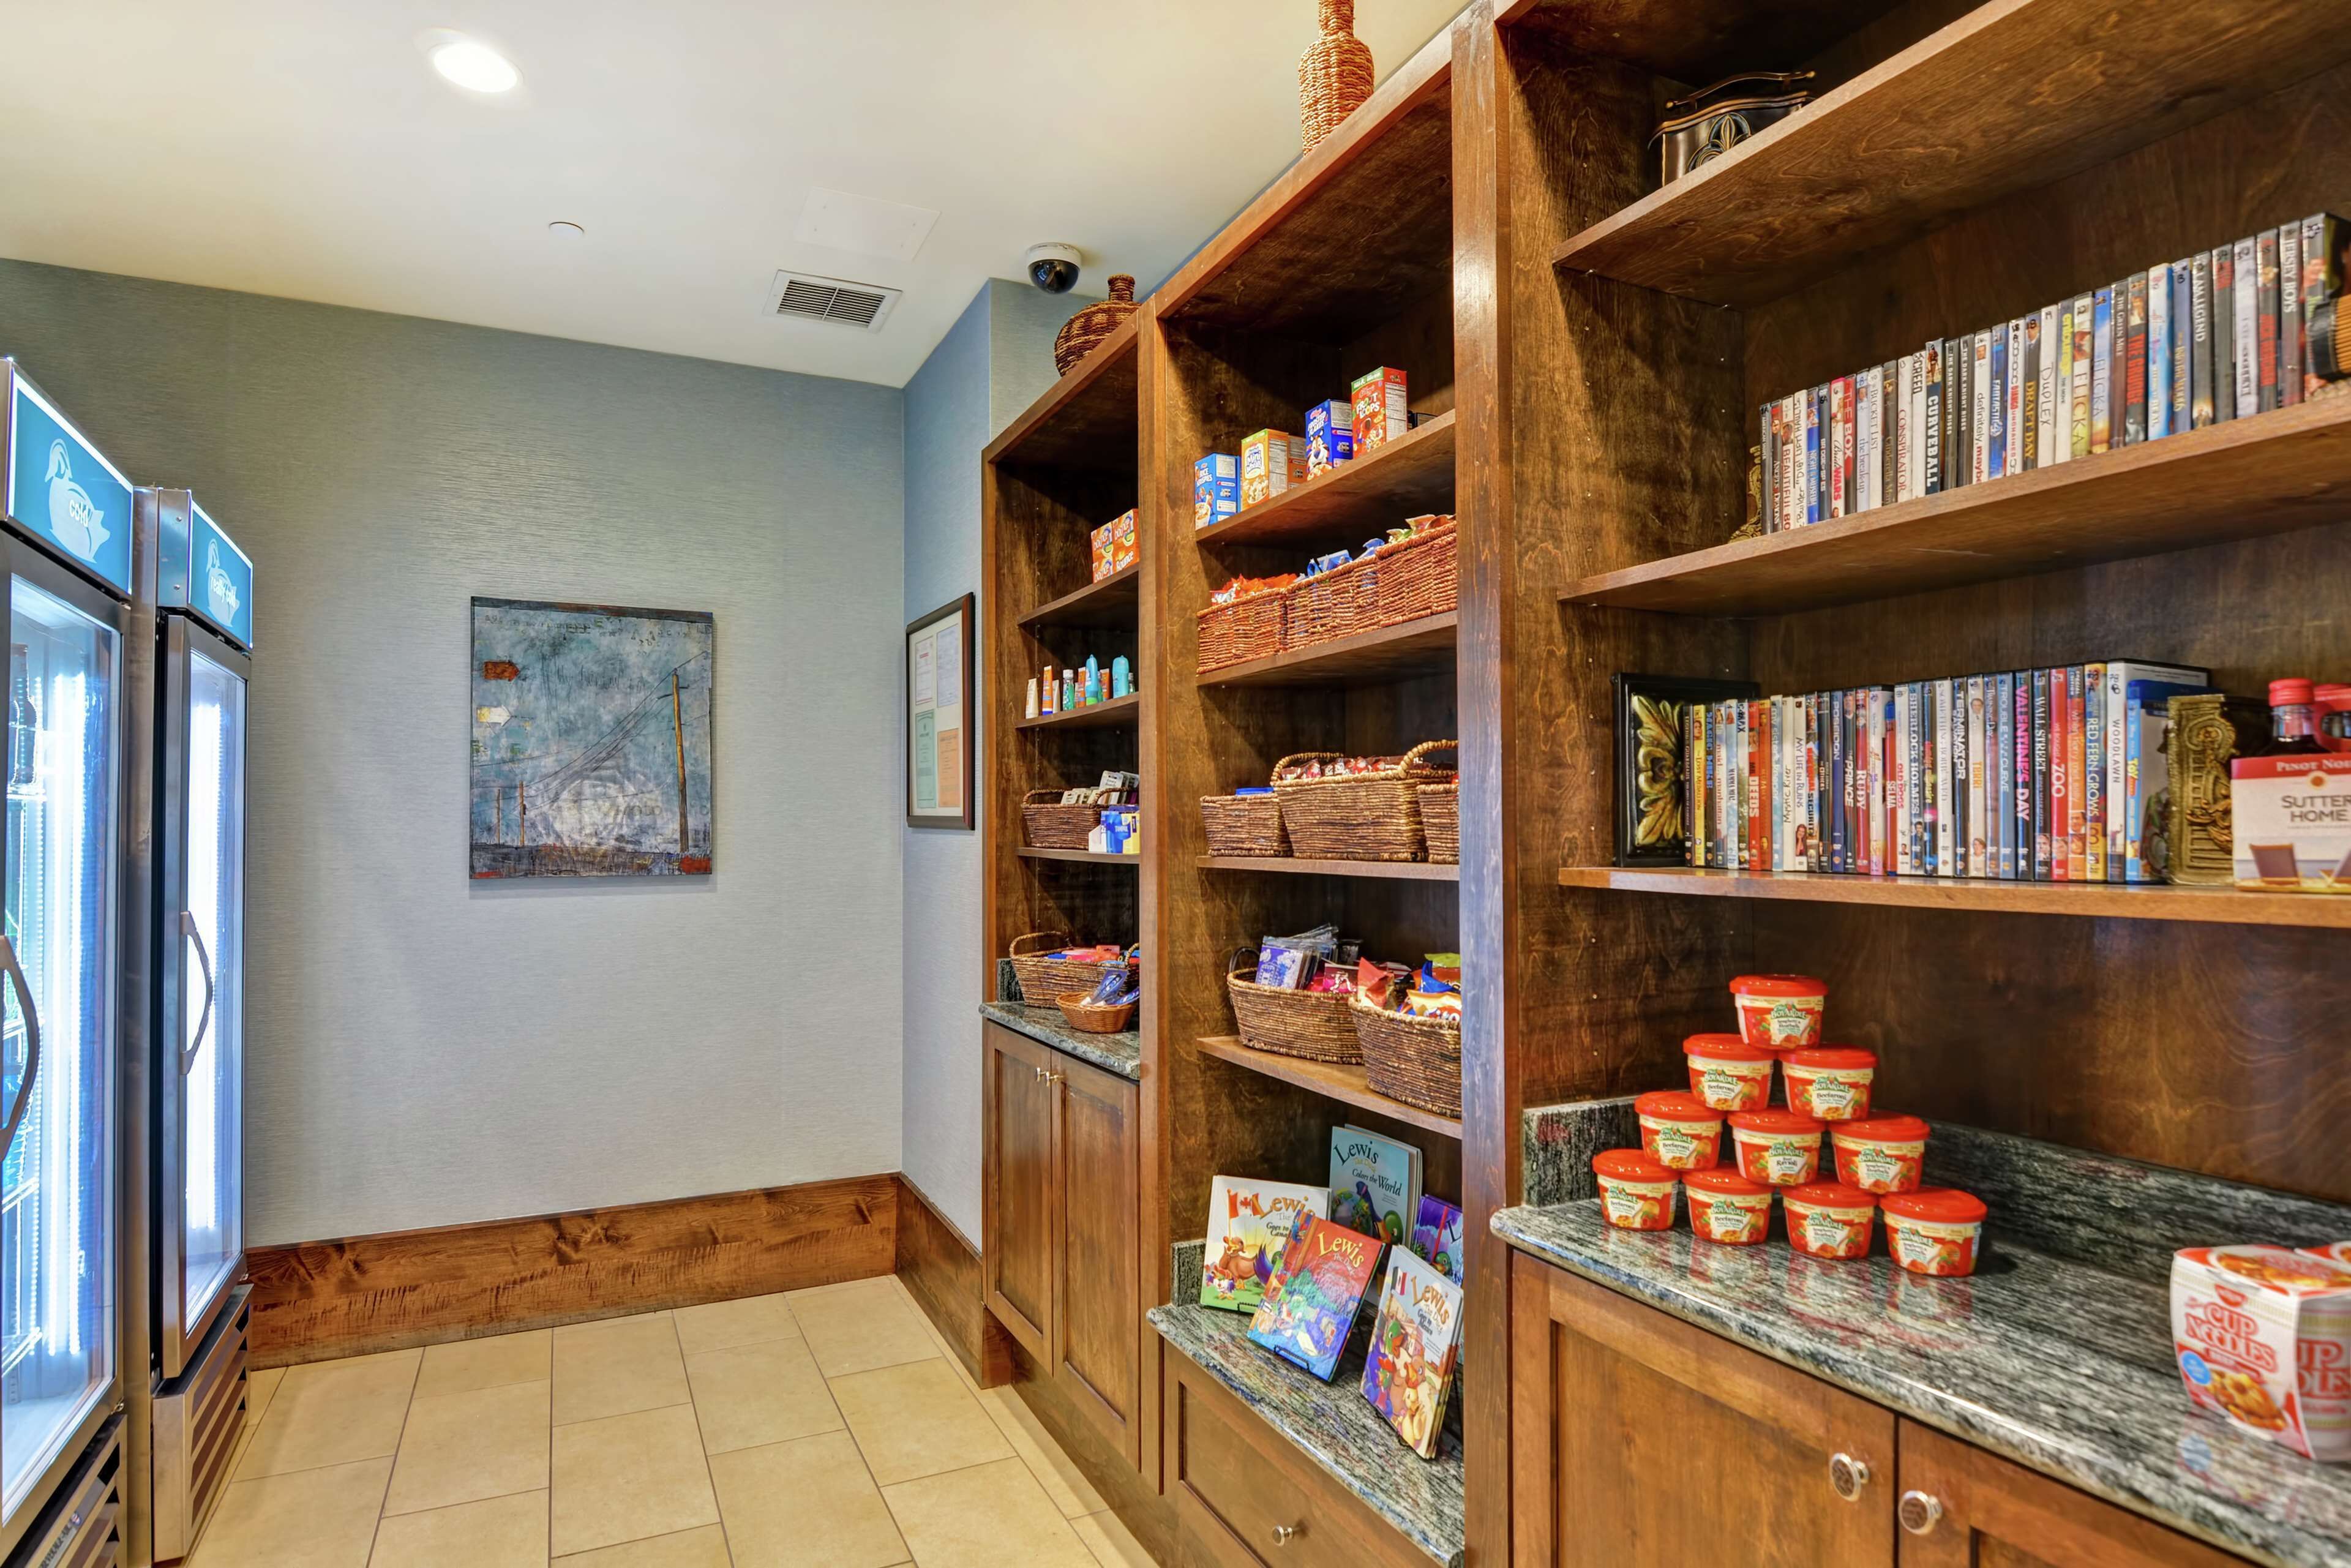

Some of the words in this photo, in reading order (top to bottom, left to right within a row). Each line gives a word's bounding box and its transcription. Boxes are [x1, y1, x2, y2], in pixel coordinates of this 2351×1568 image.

[2284, 239, 2296, 281] JERSEY
[2284, 282, 2296, 313] BOYS
[2117, 312, 2125, 337] GREEN
[2193, 298, 2206, 342] LEGEND
[2060, 313, 2072, 377] entourage
[2128, 333, 2145, 358] THE
[1913, 361, 1923, 394] CREED
[2093, 359, 2105, 418] FLICKA
[2127, 358, 2145, 407] GRUDGE
[1360, 401, 1380, 419] LOOPS
[1992, 380, 2001, 424] FANTASTIC
[2010, 385, 2019, 410] DJANGO
[2025, 381, 2036, 429] DRAFT
[2072, 372, 2088, 446] FLICKA
[1974, 392, 1985, 445] definitely,
[1247, 451, 1261, 463] Mini
[1898, 409, 1907, 492] CONSPIRATOR
[1927, 395, 1939, 487] CURVEBALL
[2025, 431, 2035, 459] DAY
[1884, 436, 1893, 482] Cinderella
[1884, 483, 1893, 503] Man
[69, 499, 89, 528] cold
[211, 576, 226, 603] really
[225, 586, 236, 608] cold
[1771, 708, 1779, 725] my
[1910, 693, 1919, 759] SHERLOCK
[2034, 697, 2045, 728] WALL
[1796, 737, 1803, 753] MY
[1957, 691, 1965, 779] TERMINATOR
[1987, 722, 1997, 738] DAY
[2015, 685, 2029, 782] VALENTINE'S
[2087, 718, 2099, 740] RED
[2035, 729, 2046, 771] STREET
[2088, 743, 2099, 770] FERN
[1796, 772, 1801, 781] IN
[2051, 763, 2065, 797] ZOO
[2127, 758, 2139, 779] TOY
[2276, 761, 2320, 772] PINOT
[1749, 776, 1759, 817] DEEDS
[1856, 770, 1866, 809] RUDY
[1887, 781, 1896, 808] SELMA
[1910, 762, 1919, 814] HOLMES
[2088, 774, 2099, 816] GROWS
[2282, 795, 2351, 809] SUTTER
[1783, 791, 1792, 823] Mystic
[2016, 788, 2029, 821] DAY
[2290, 809, 2349, 823] HOME
[1817, 1092, 1847, 1101] Beefaroni
[1333, 1141, 1379, 1166] Lewis
[1662, 1142, 1690, 1151] Beefaroni
[1352, 1168, 1369, 1181] Colors
[1369, 1175, 1378, 1184] the
[1378, 1175, 1402, 1196] World
[1266, 1222, 1280, 1232] Goes
[1318, 1231, 1365, 1268] Lewis
[1411, 1275, 1450, 1325] Lewis
[2205, 1302, 2258, 1336] CUP
